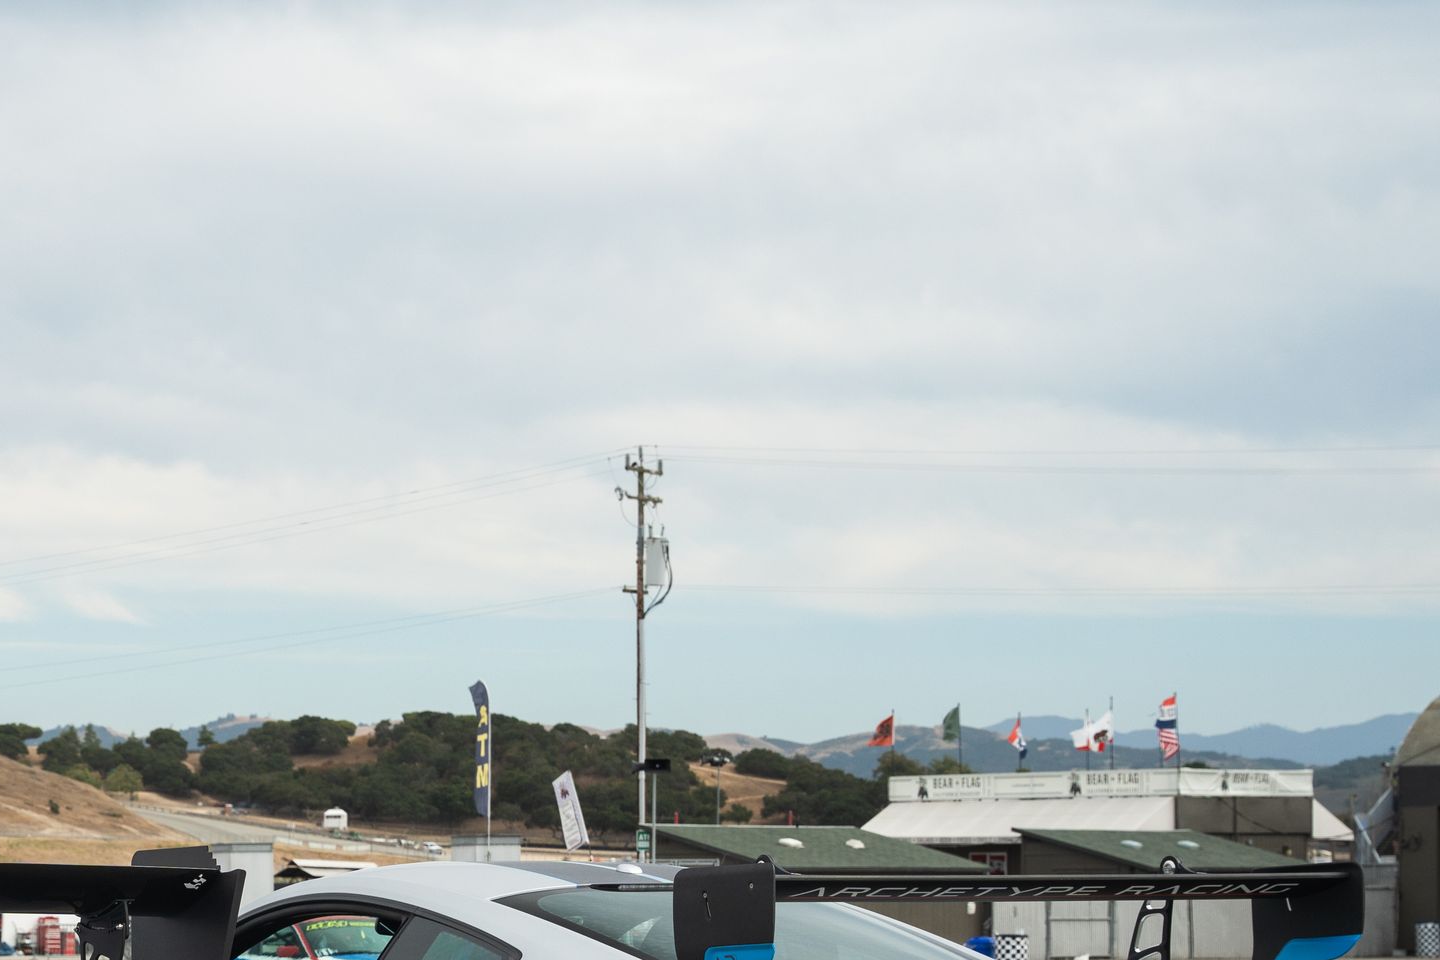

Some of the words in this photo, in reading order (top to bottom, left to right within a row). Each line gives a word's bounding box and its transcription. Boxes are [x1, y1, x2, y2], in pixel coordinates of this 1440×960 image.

[476, 705, 488, 788] ATM
[791, 885, 1106, 898] ARCHETYPE
[1115, 883, 1300, 895] RACING
